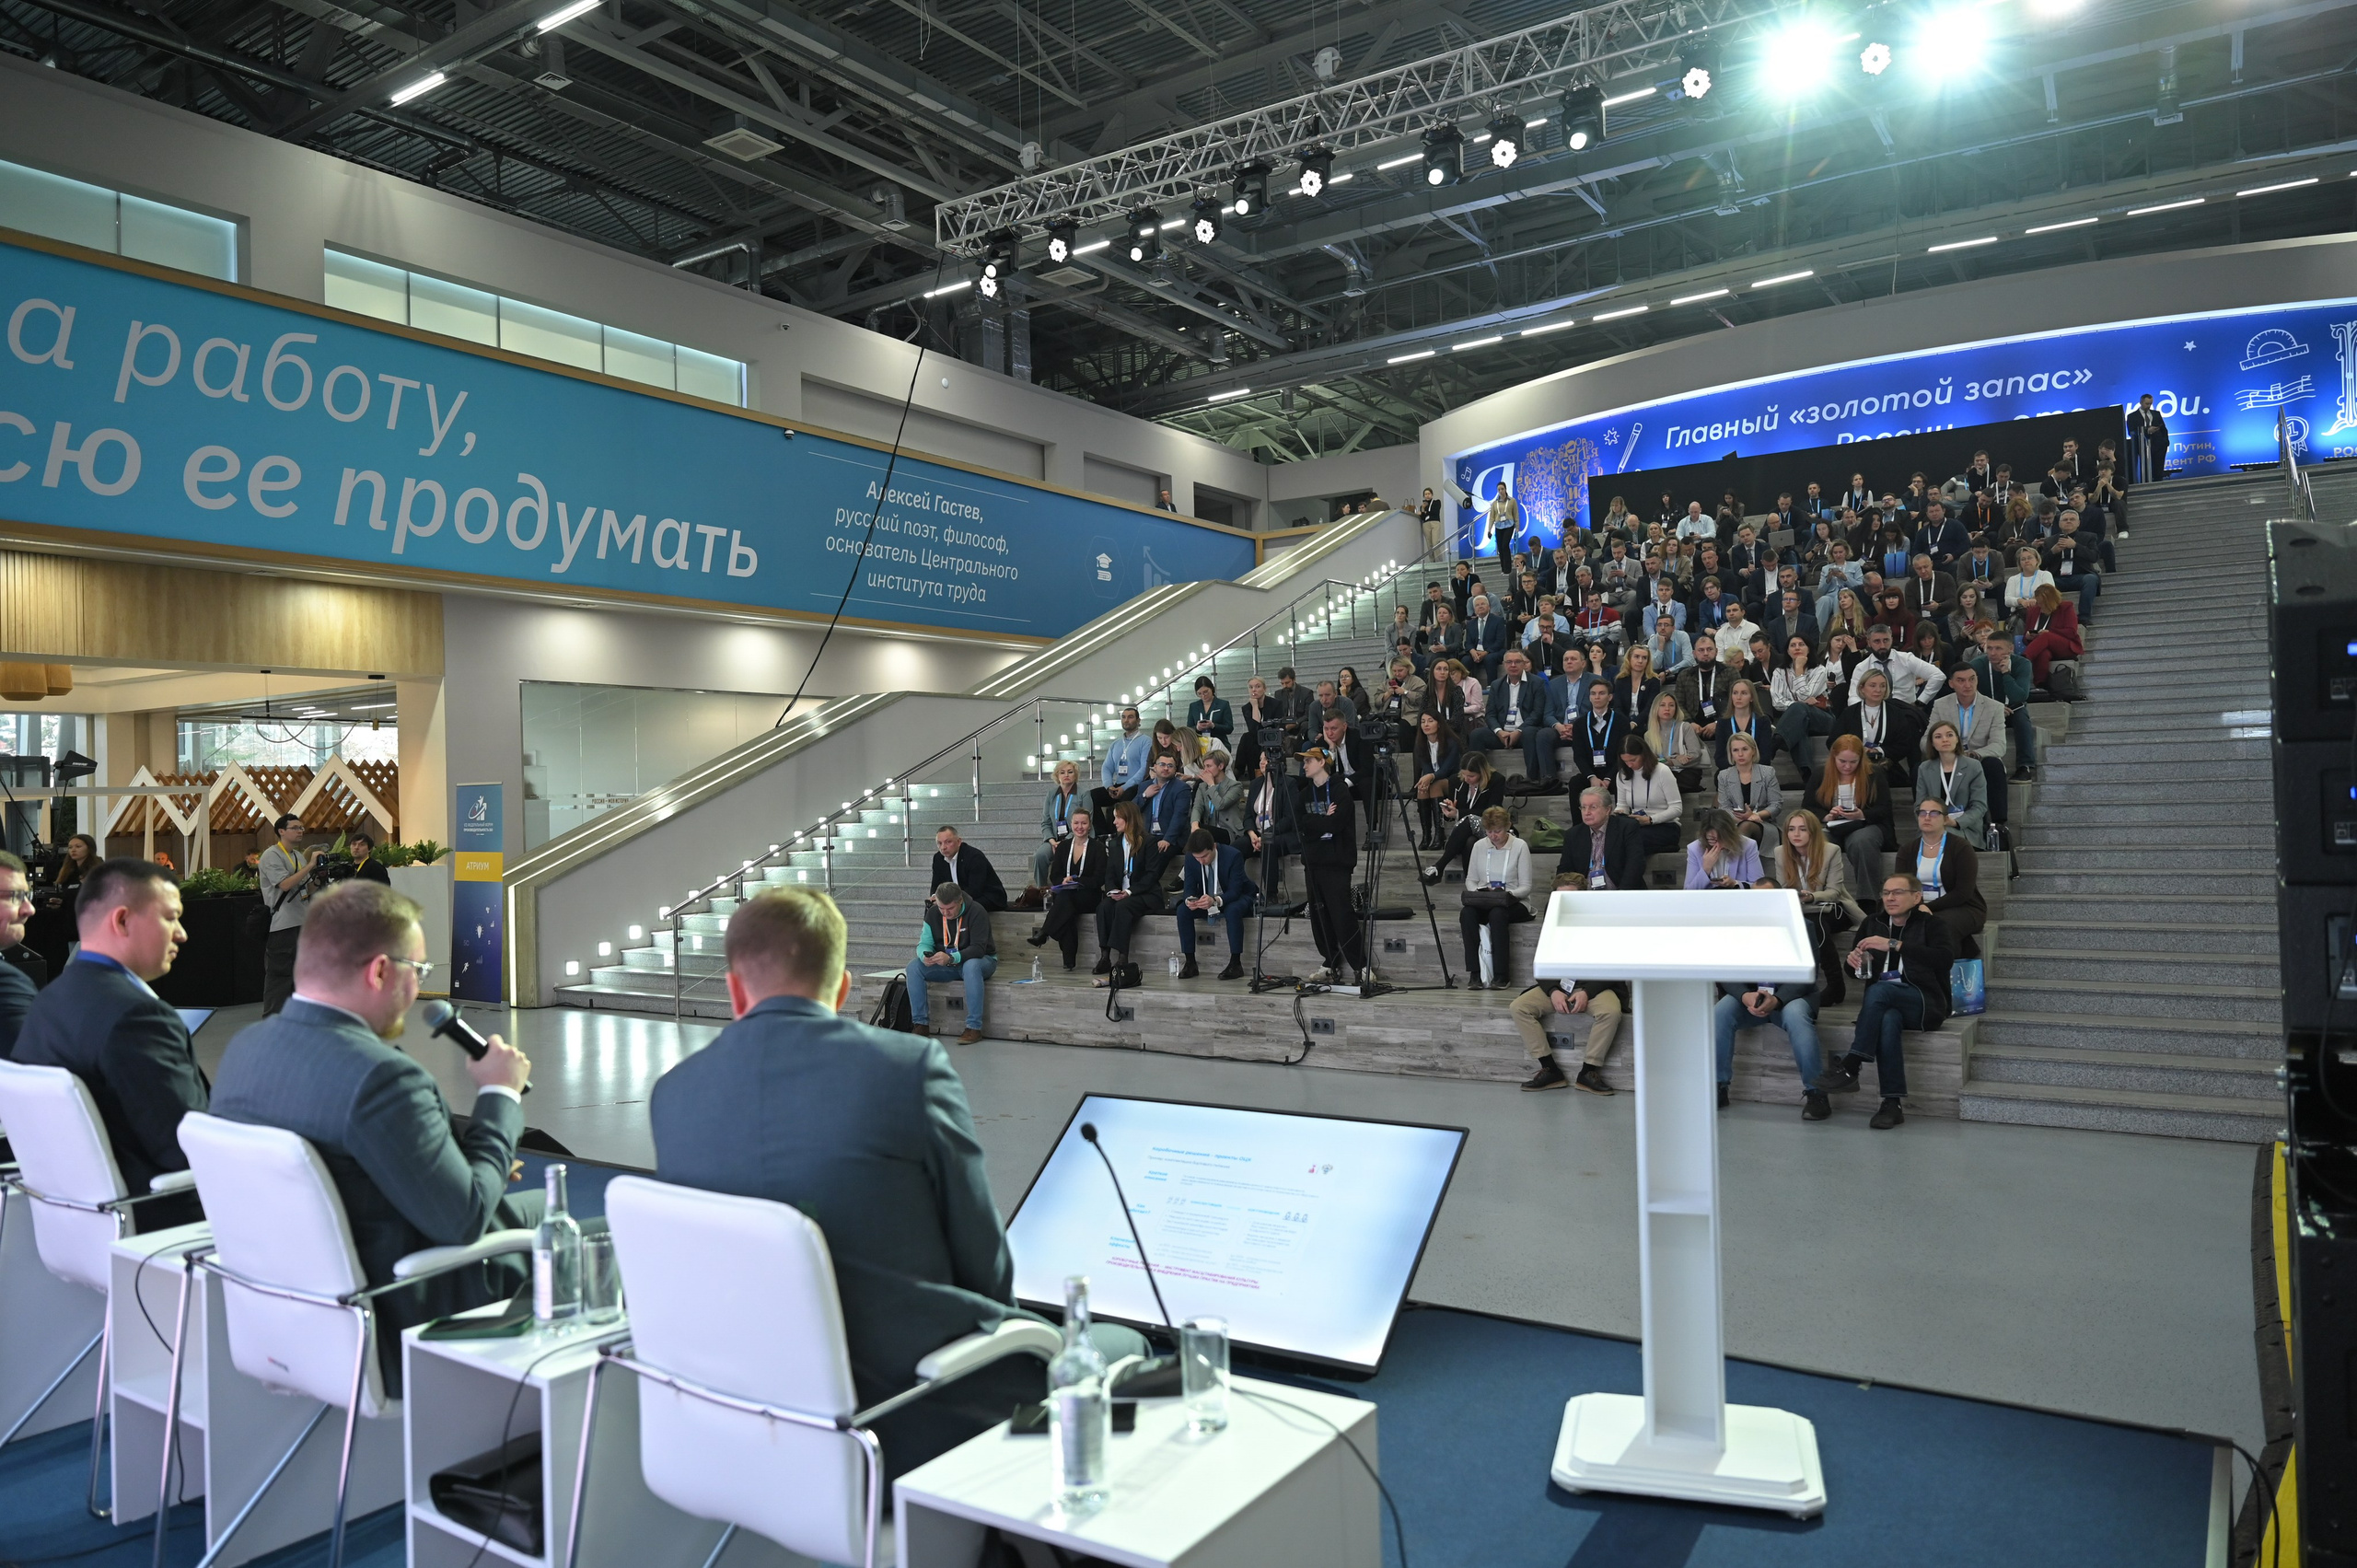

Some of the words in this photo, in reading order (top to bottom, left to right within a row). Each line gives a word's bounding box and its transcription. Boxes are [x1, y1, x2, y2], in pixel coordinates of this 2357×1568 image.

[114, 319, 477, 458] работу,
[1666, 404, 1779, 449] Главный
[1789, 376, 1953, 424] «золотой
[1964, 368, 2094, 401] запас»
[2164, 457, 2193, 468] дент
[2197, 454, 2216, 464] РФ
[2174, 442, 2215, 453] Путин,
[183, 444, 302, 518] ее
[332, 467, 759, 578] продумать
[866, 481, 931, 512] Алексей
[934, 494, 984, 524] Гастев,
[835, 507, 900, 532] русский
[904, 519, 939, 542] поэт,
[943, 526, 1010, 555] философ,
[826, 536, 917, 564] основатель
[921, 548, 1018, 581] Центрального
[867, 572, 943, 598] института
[946, 584, 987, 604] труда
[466, 862, 489, 871] АТРИУМ
